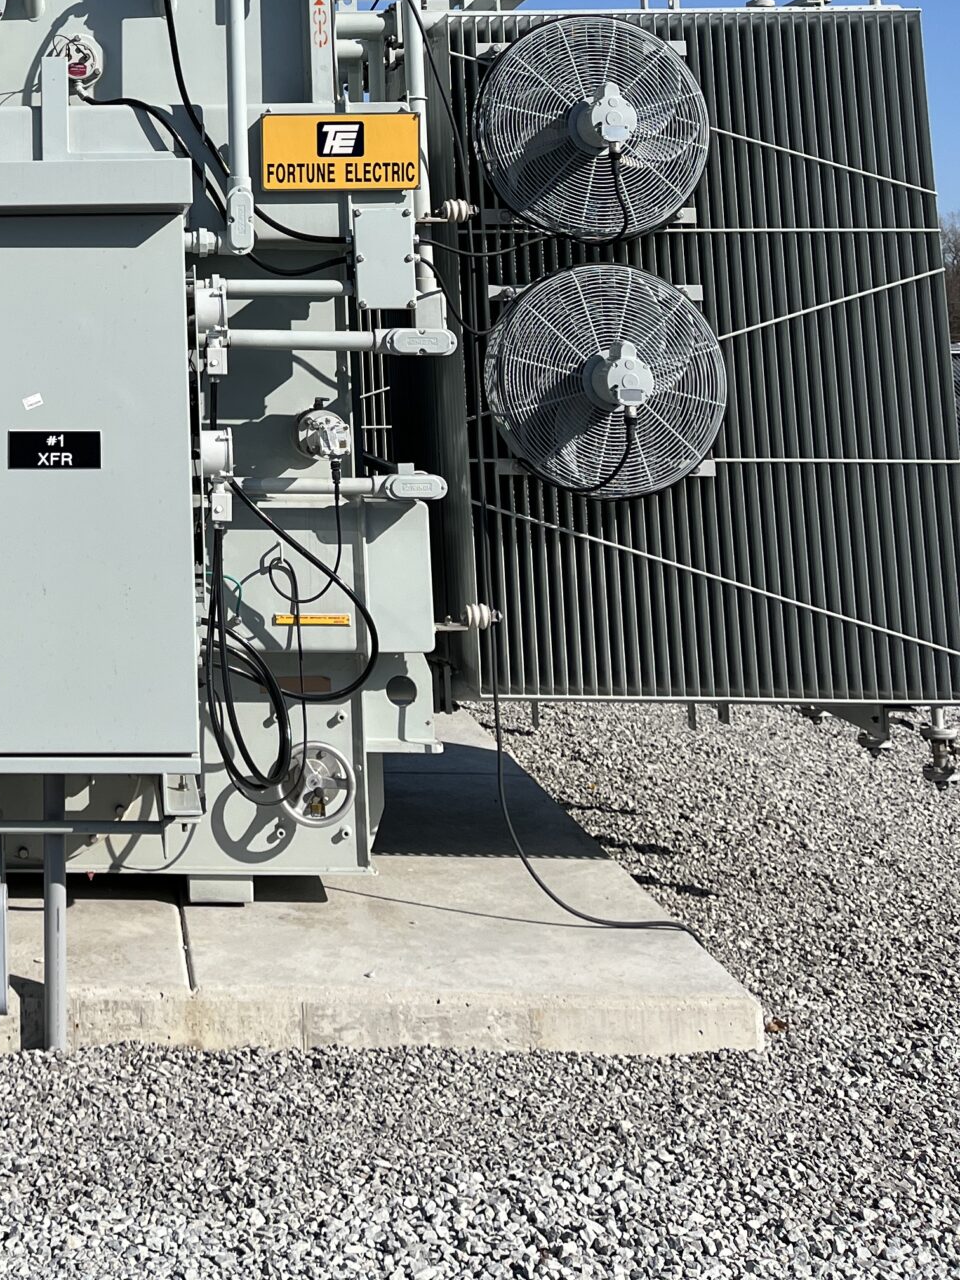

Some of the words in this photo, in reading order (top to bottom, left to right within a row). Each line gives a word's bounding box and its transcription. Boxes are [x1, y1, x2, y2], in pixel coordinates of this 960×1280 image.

[267, 163, 336, 183] FORTUNE
[345, 162, 415, 183] ELECTRIC
[46, 434, 64, 447] #1
[37, 452, 73, 466] XFR
